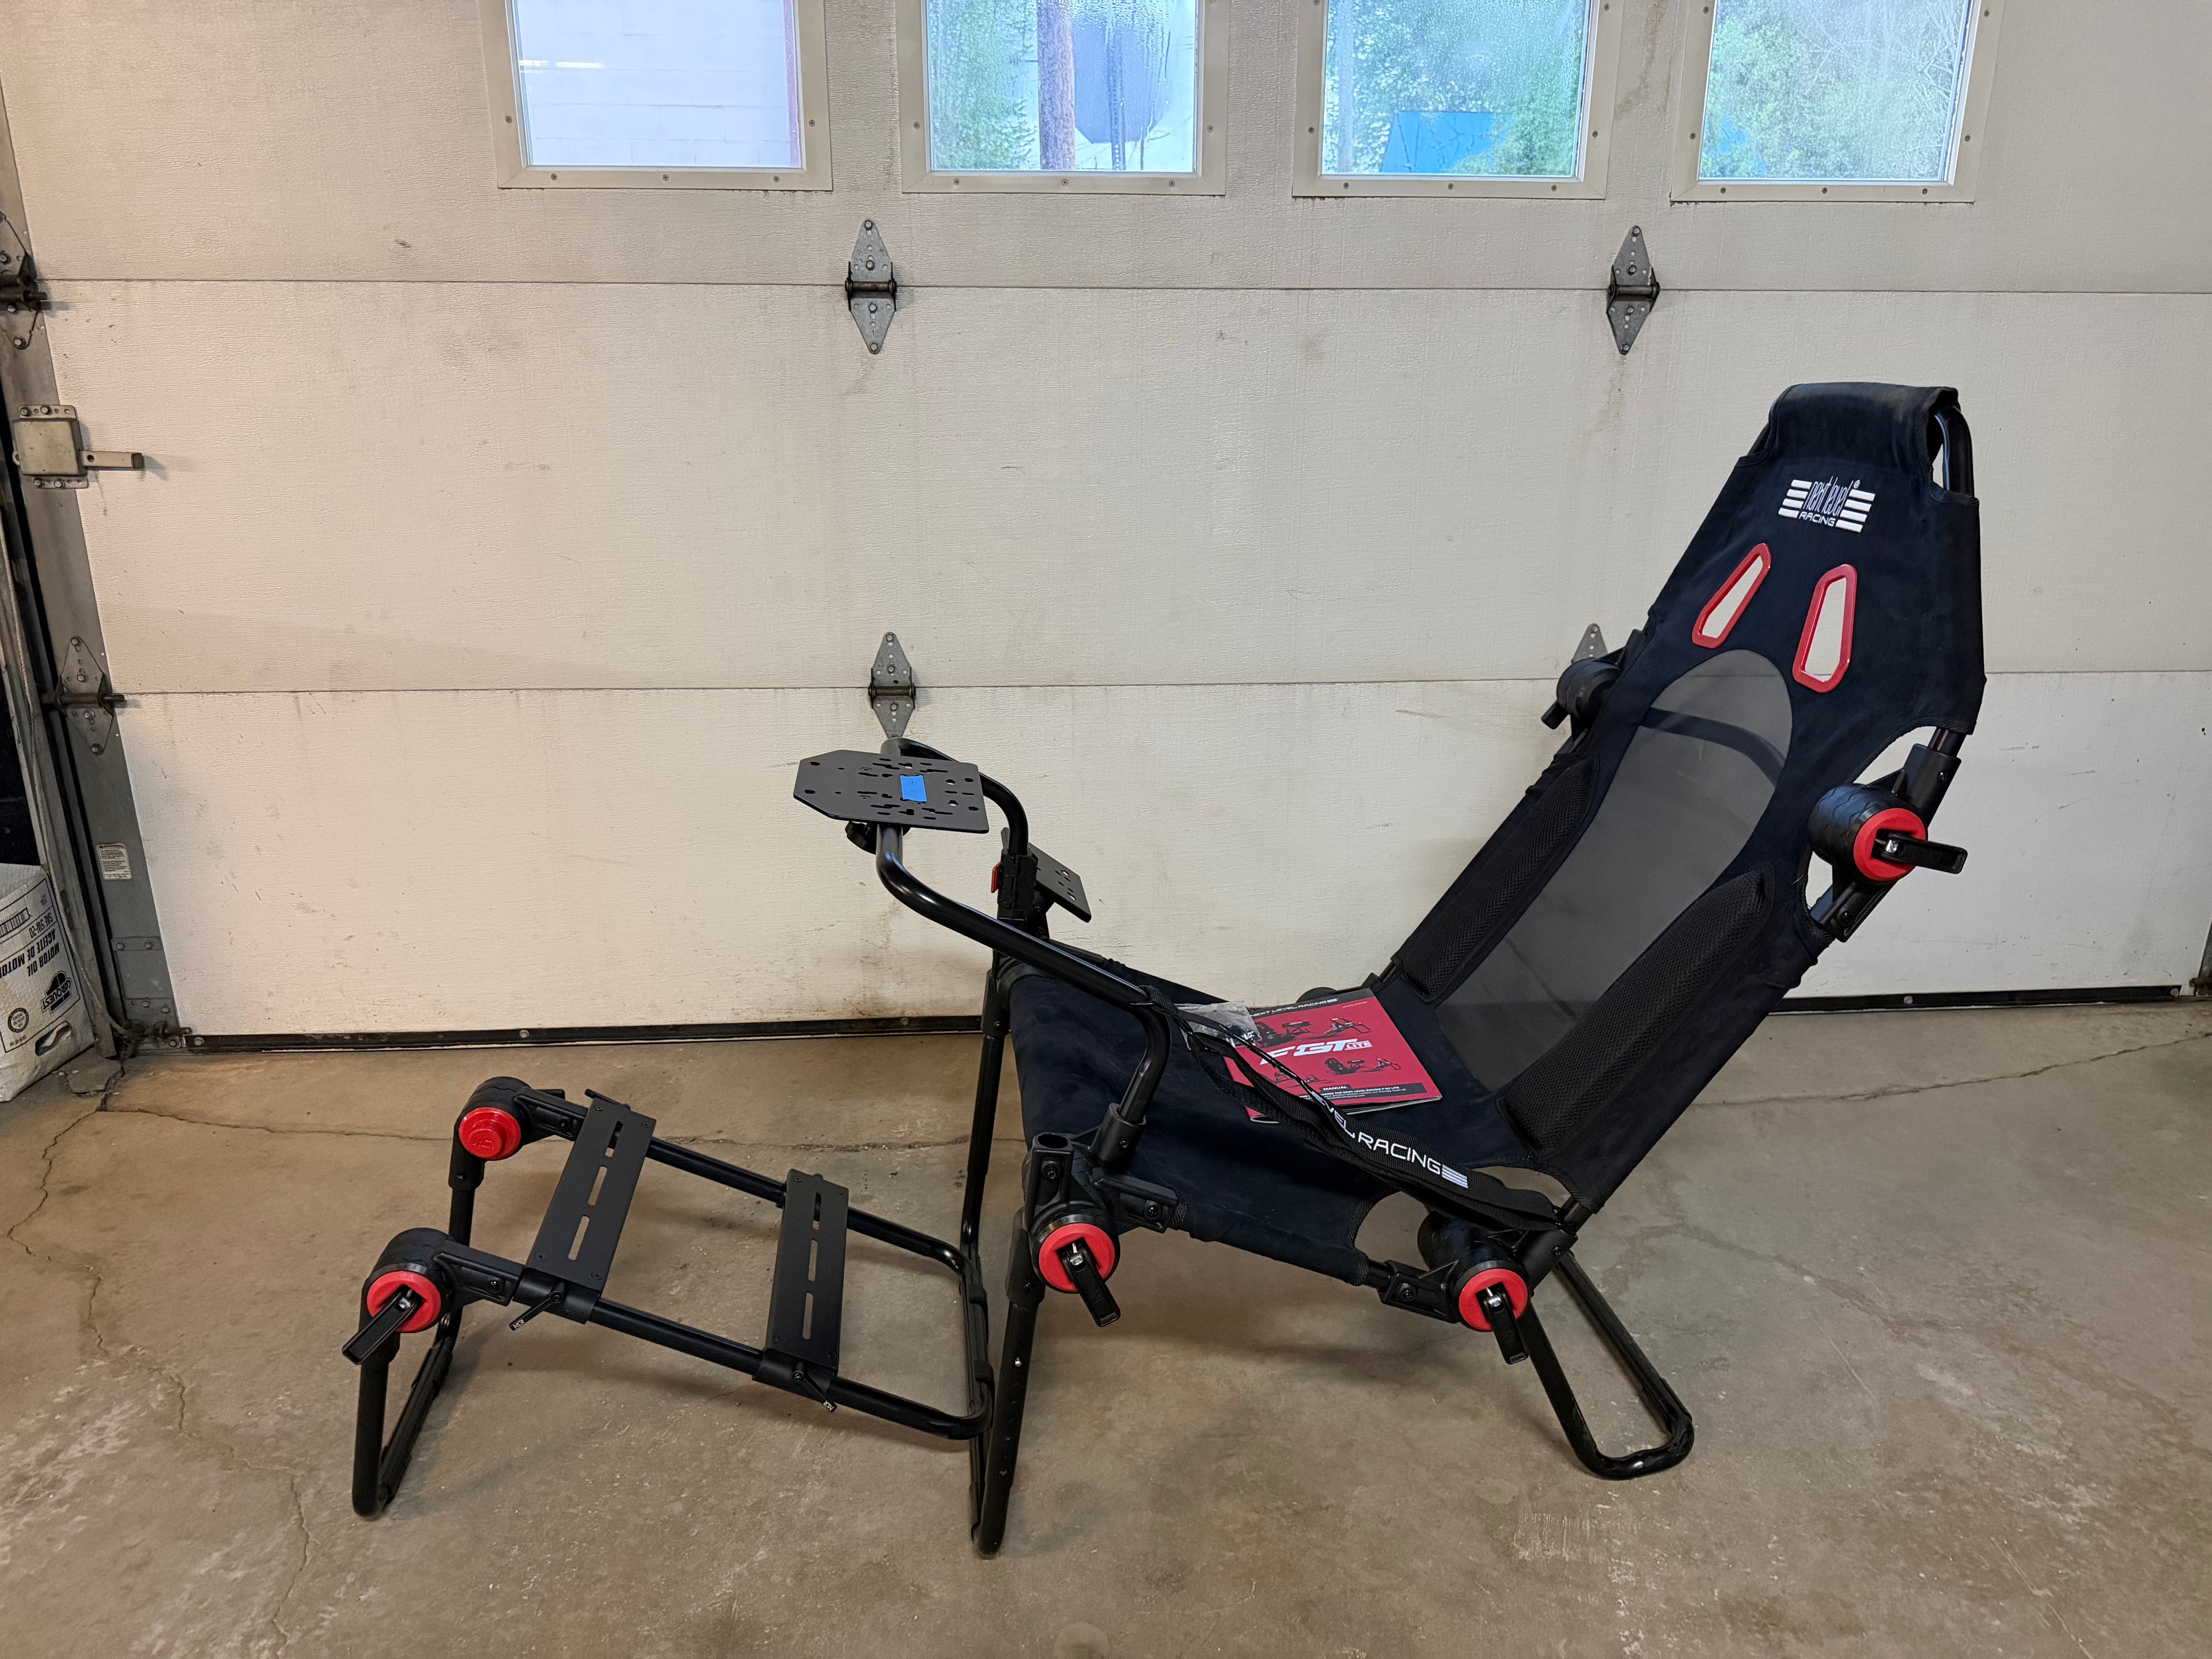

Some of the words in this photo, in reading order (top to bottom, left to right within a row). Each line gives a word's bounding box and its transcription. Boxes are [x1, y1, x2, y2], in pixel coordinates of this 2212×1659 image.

[1798, 512, 1836, 527] RACING
[29, 919, 45, 938] 5W-20
[36, 929, 55, 954] ACEITE
[27, 946, 35, 961] DE
[39, 942, 60, 968] MOTOR
[26, 960, 38, 978] OIL
[43, 979, 71, 1010] CARQUEST
[1298, 1000, 1327, 1008] RACING
[1346, 1041, 1372, 1049] LITE
[1358, 1131, 1441, 1175] RACING
[513, 1319, 525, 1329] NLR
[823, 1400, 834, 1411] NLR
